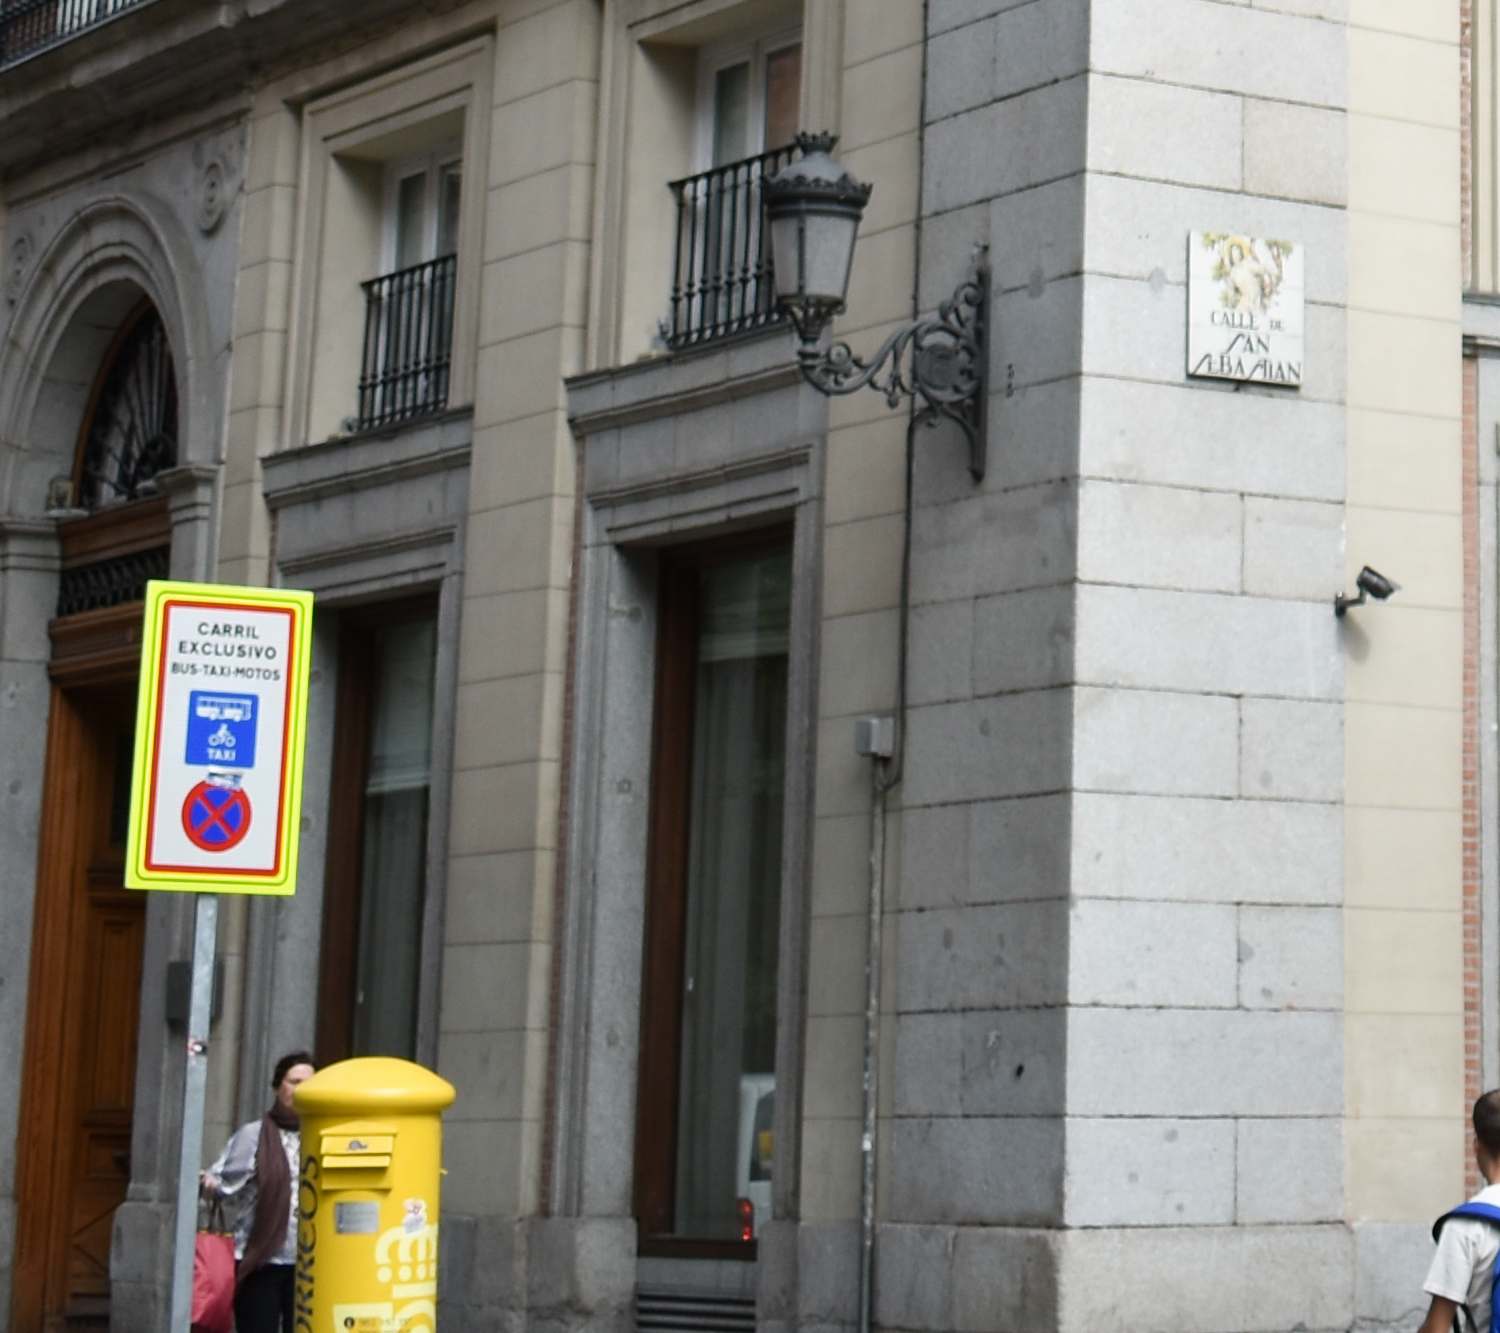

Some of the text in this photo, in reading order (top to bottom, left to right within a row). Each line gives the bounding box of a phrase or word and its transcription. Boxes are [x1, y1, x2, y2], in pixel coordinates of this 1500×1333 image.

[1210, 311, 1284, 331] CALLE DE
[1226, 332, 1271, 354] SAN
[197, 621, 260, 640] CARRIL
[178, 639, 278, 661] EXCLUSIVO
[171, 662, 282, 682] BUS-TAXI-MOTOS
[207, 748, 236, 762] TAXI
